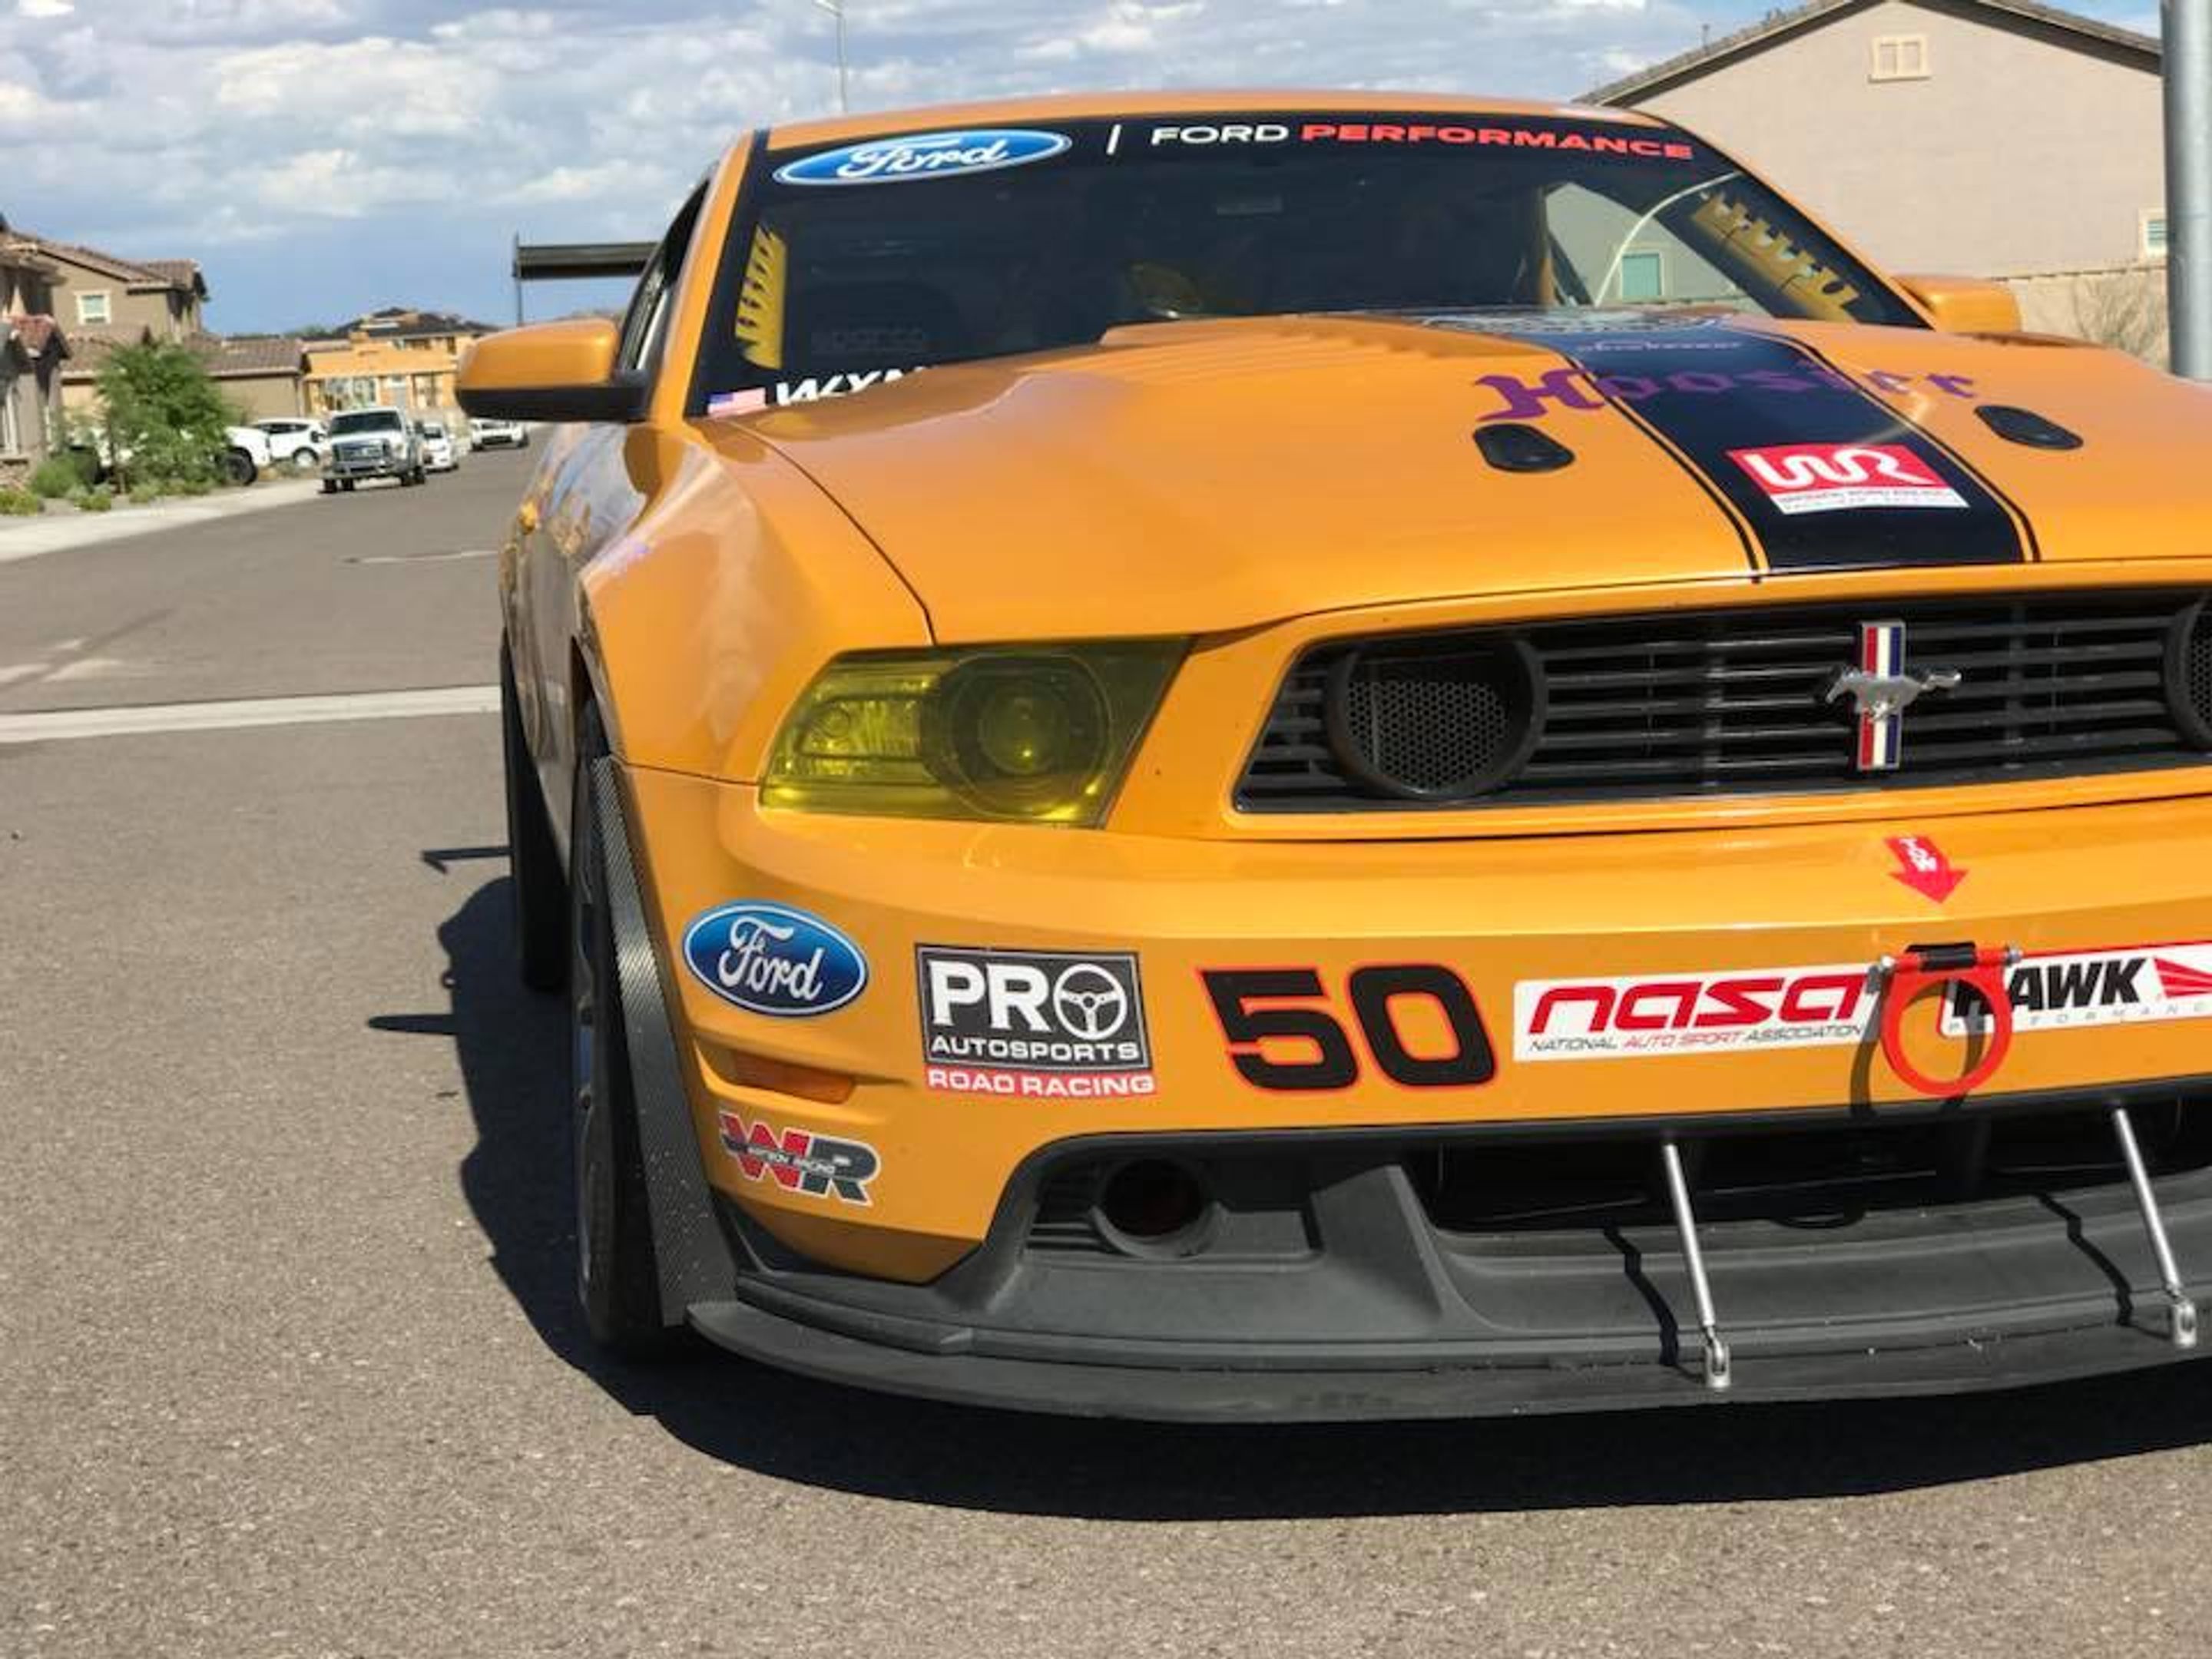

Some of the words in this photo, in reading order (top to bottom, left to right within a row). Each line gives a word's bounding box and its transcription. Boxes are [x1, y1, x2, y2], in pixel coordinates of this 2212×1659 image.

[837, 137, 1008, 178] Ford
[1151, 125, 1290, 145] FORD
[1302, 124, 1694, 160] PERFORMANCE
[718, 916, 825, 1000] Ford
[1200, 965, 1496, 1092] 50
[1529, 1037, 1618, 1052] NATIONAL
[1623, 1034, 1674, 1049] AUTO
[1677, 1031, 1743, 1046] SPORT
[1743, 1024, 1863, 1044] ASSOCIATION
[931, 1035, 1140, 1061] AUTOSPORTS
[927, 1068, 1015, 1094] ROAD
[1021, 1075, 1155, 1097] RACING
[719, 1111, 880, 1207] WR
